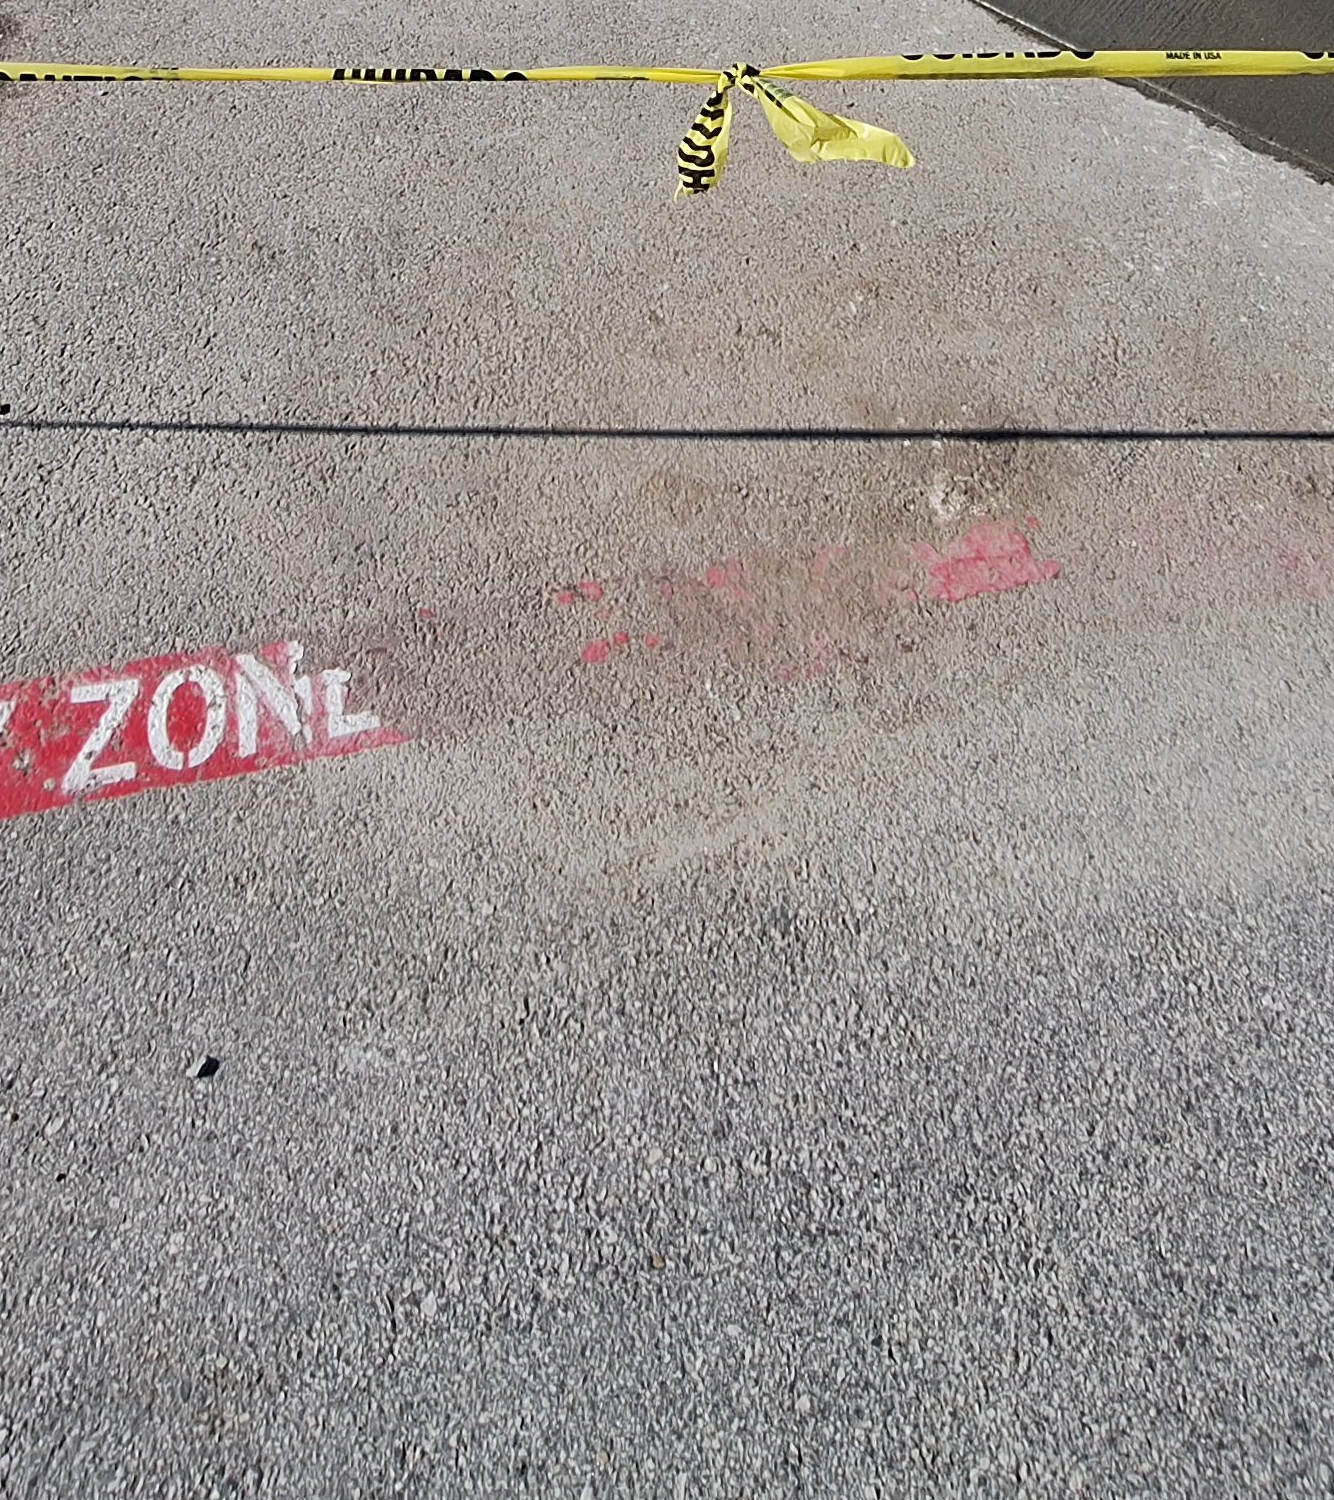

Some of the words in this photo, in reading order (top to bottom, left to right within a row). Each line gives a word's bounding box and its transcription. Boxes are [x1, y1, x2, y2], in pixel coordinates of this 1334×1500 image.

[1165, 51, 1190, 60] MADE
[1192, 51, 1202, 60] IN
[1204, 51, 1222, 60] USA
